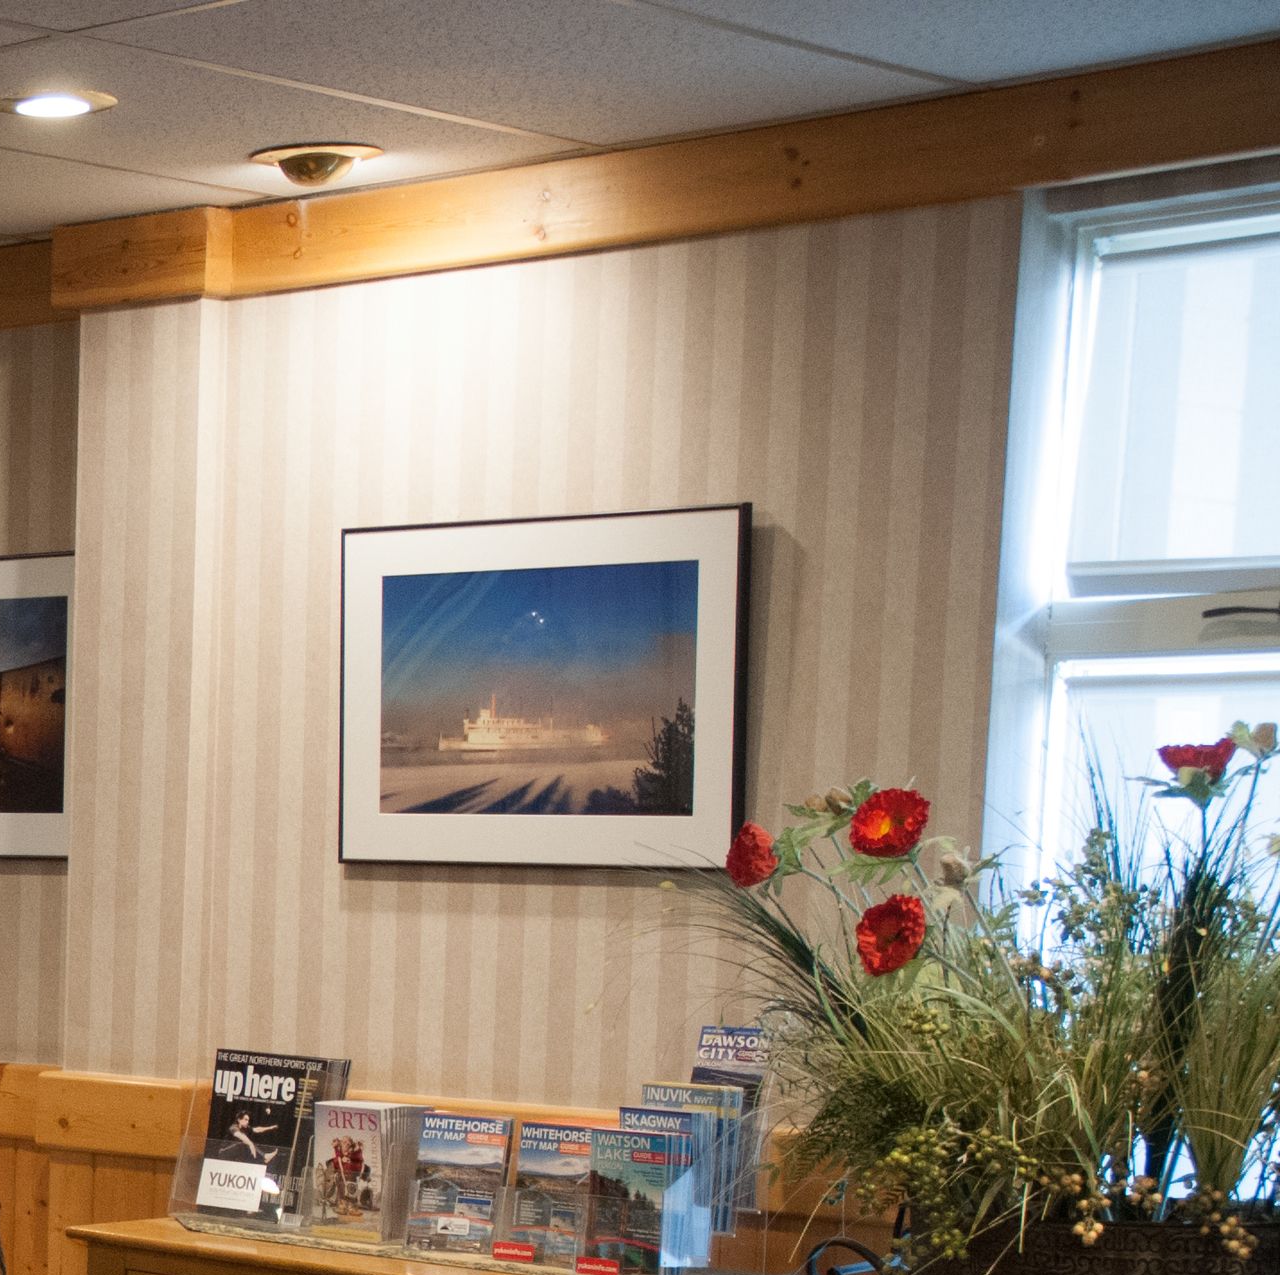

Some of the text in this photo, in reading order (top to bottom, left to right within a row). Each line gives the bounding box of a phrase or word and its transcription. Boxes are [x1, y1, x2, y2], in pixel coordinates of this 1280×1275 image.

[701, 1034, 769, 1048] DAWSON
[217, 1052, 229, 1062] THE
[229, 1053, 249, 1063] GREAT
[249, 1055, 283, 1067] NORTHERN
[283, 1059, 306, 1070] SPORTS
[699, 1048, 736, 1060] CITY
[214, 1069, 244, 1102] up
[244, 1065, 296, 1102] here
[647, 1088, 692, 1103] INUVIK
[424, 1117, 504, 1134] WHITEHORSE
[624, 1113, 682, 1129] SKAGWAY
[422, 1129, 442, 1140] CITY
[443, 1131, 466, 1141] MAP
[522, 1126, 592, 1143] WHITEHORSE
[597, 1133, 651, 1149] WATSON
[521, 1139, 538, 1150] CITY
[539, 1141, 558, 1151] MAP
[597, 1149, 631, 1161] LAKE
[209, 1171, 257, 1191] YUKON
